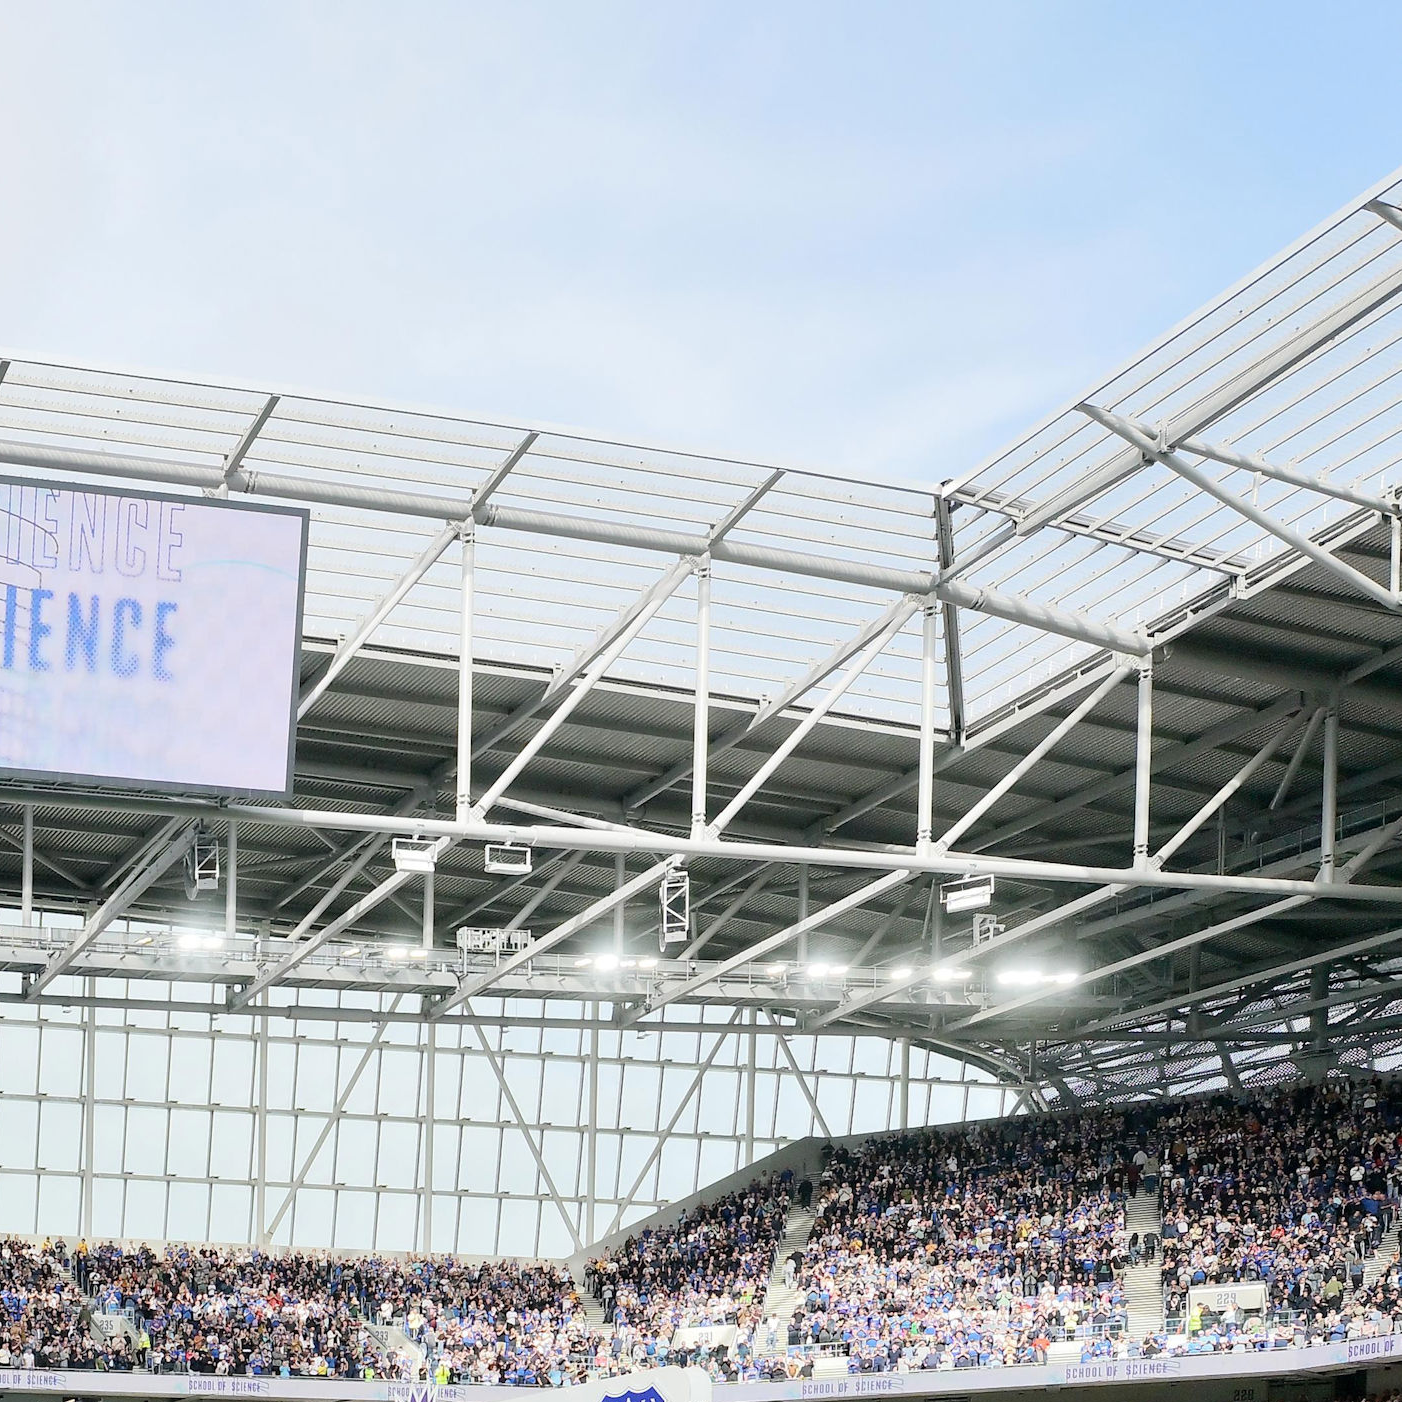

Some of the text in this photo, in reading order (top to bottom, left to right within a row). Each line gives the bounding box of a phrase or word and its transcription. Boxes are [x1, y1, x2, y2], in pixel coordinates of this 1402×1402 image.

[1216, 1292, 1237, 1305] 229
[99, 1319, 114, 1331] 235
[1348, 1339, 1395, 1358] SCHOOL OF
[1066, 1362, 1168, 1379] SCHOOL OF SCIENCE
[13, 1373, 22, 1386] OF
[27, 1373, 57, 1387] SCIENCE
[188, 1379, 261, 1393] SCHOOL OF SCIENCE
[802, 1377, 893, 1395] SCHOOL OF SCIENCE
[388, 1386, 410, 1397] SCHOO
